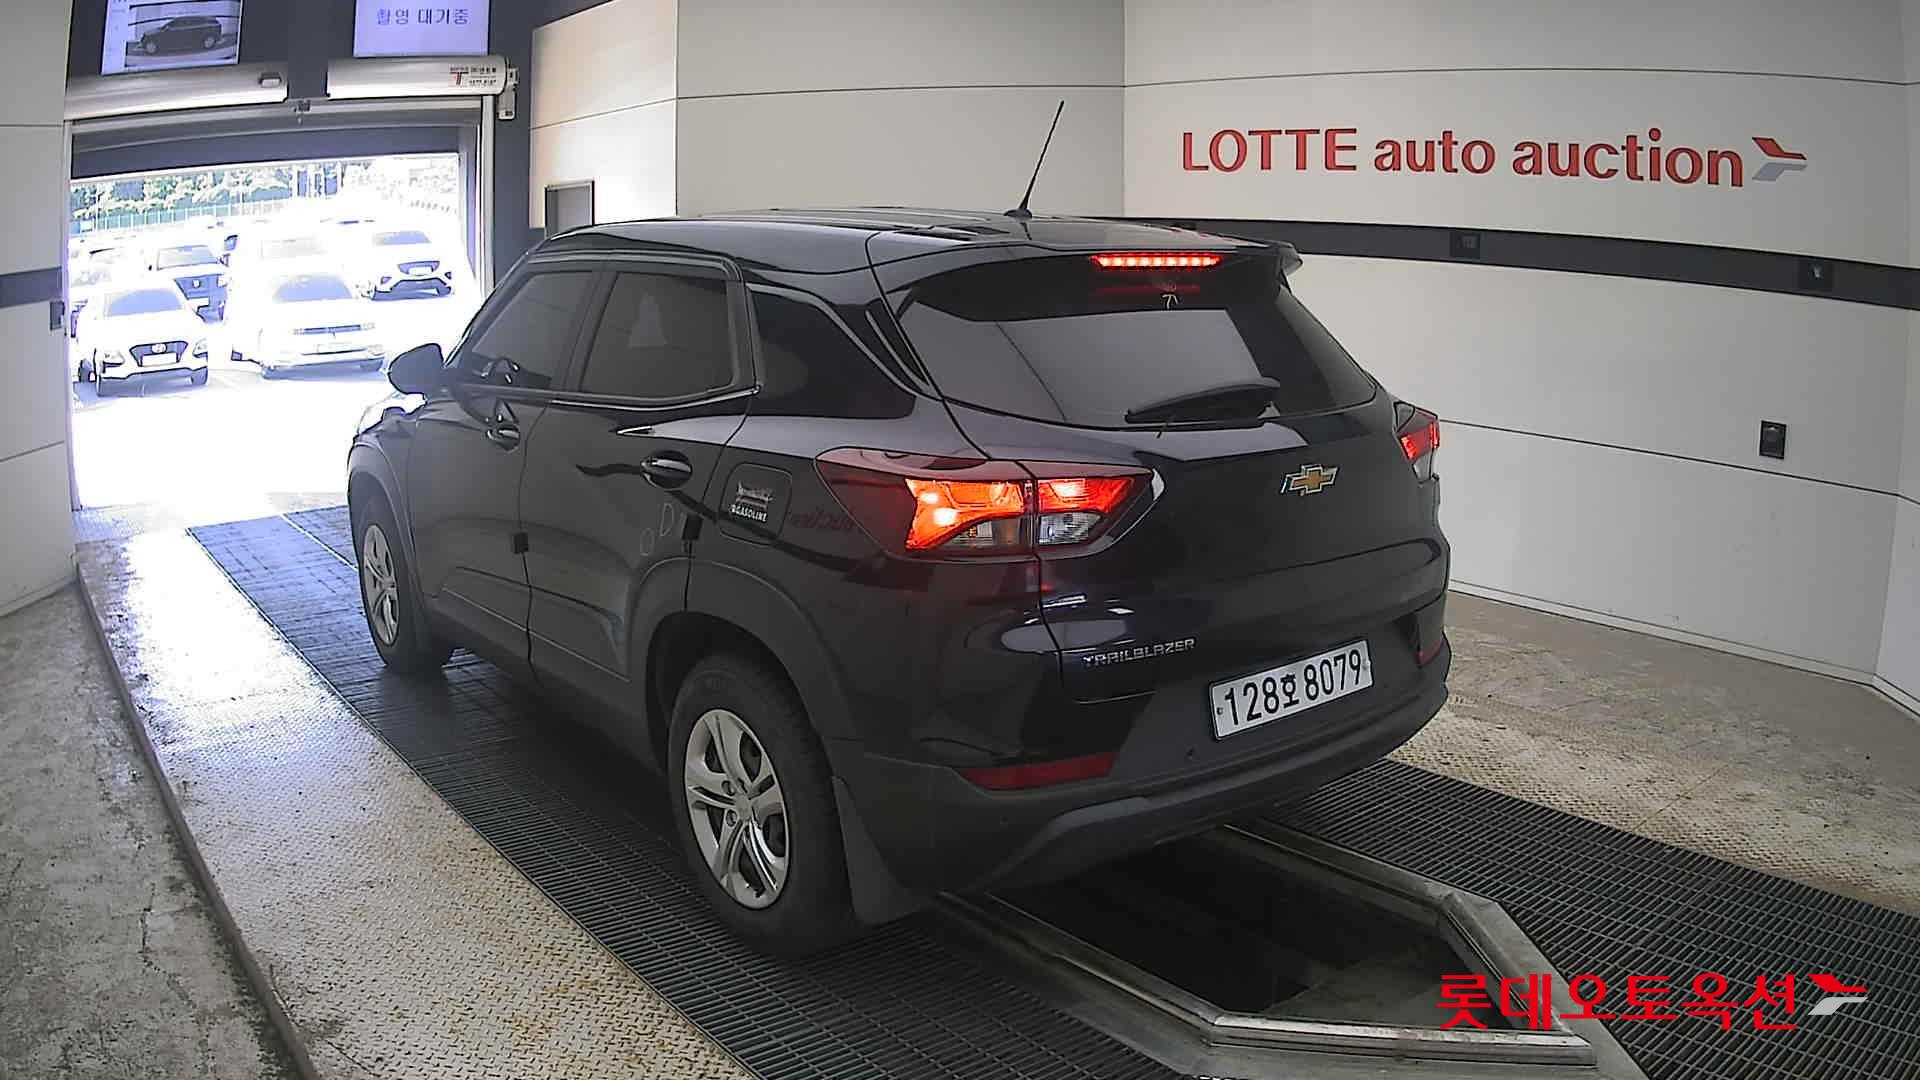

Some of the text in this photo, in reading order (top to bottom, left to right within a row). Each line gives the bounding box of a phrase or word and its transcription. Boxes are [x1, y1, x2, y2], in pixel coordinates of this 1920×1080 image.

[417, 7, 470, 25] 대기중
[1183, 127, 1744, 187] LOTTE auto auction
[1081, 637, 1196, 667] TRAILBLAZER
